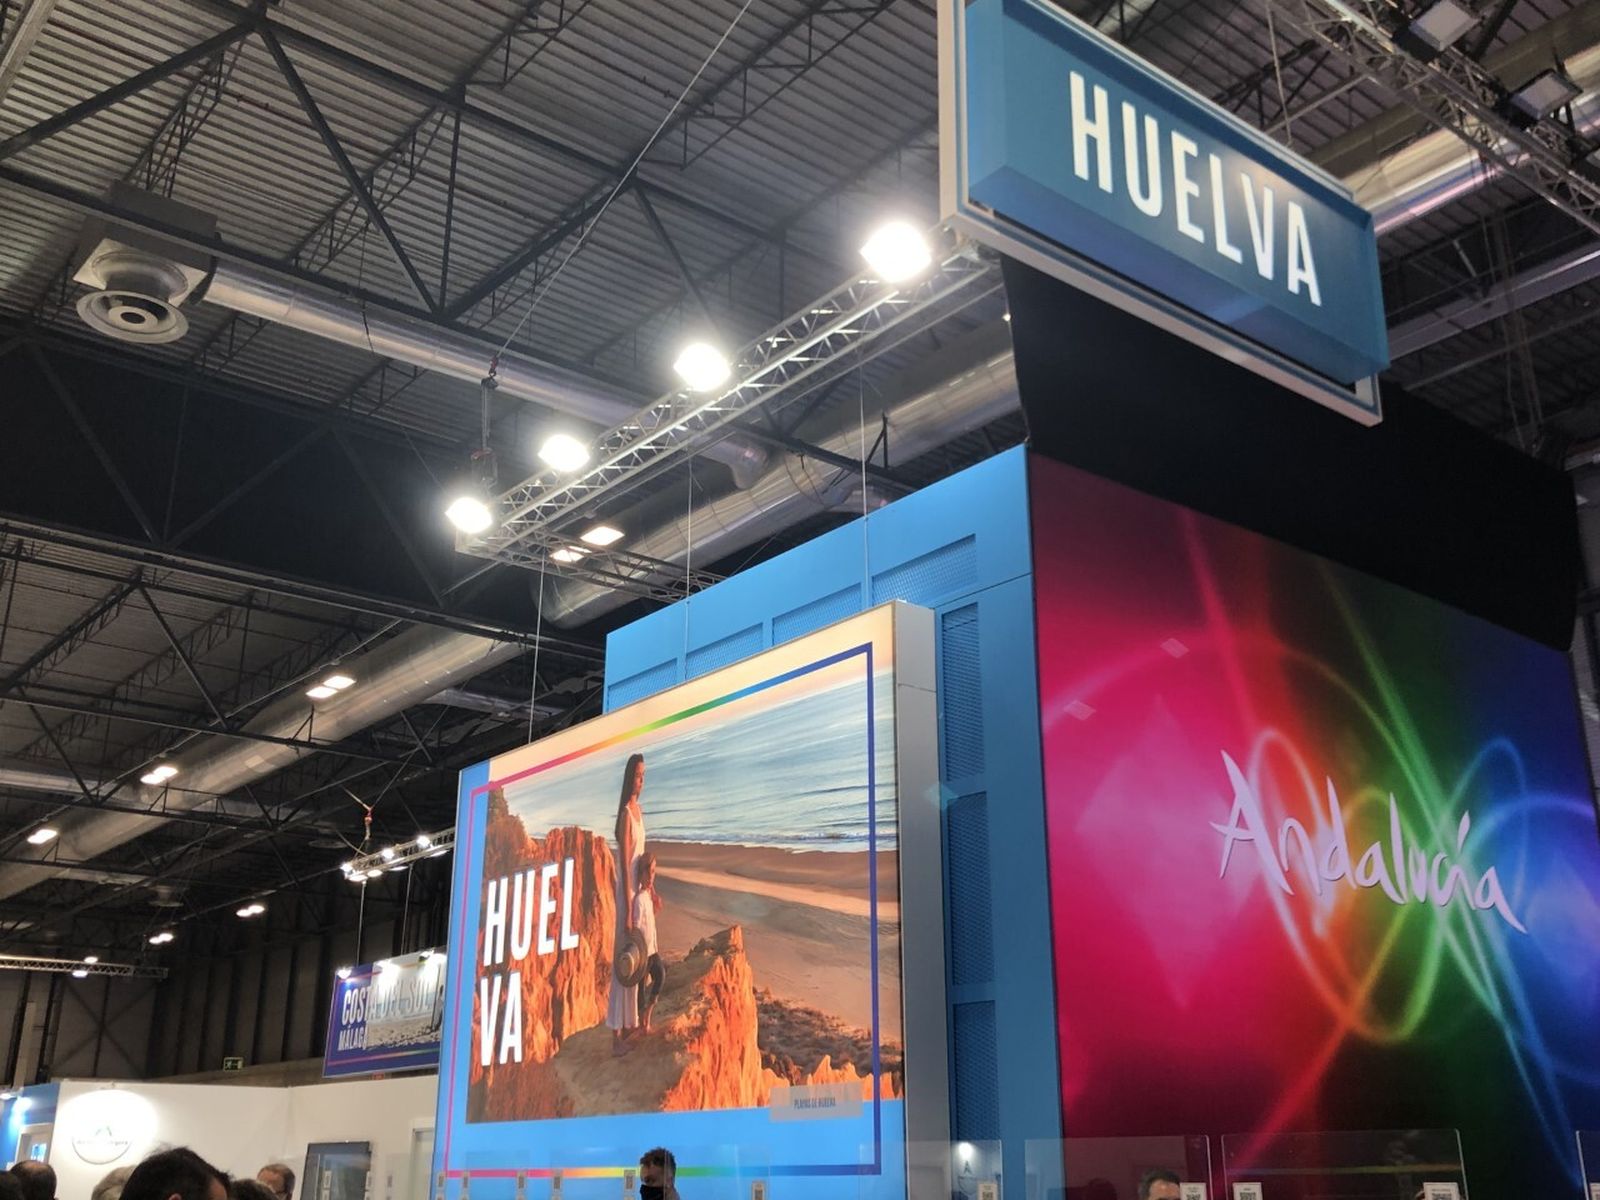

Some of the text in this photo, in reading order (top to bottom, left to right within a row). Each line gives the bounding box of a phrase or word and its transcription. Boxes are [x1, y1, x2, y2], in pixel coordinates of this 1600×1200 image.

[1069, 71, 1322, 307] HUELVA
[1208, 749, 1528, 935] Andalucía
[482, 856, 580, 967] HUEL
[341, 985, 377, 1026] COSTA
[479, 972, 523, 1067] VA
